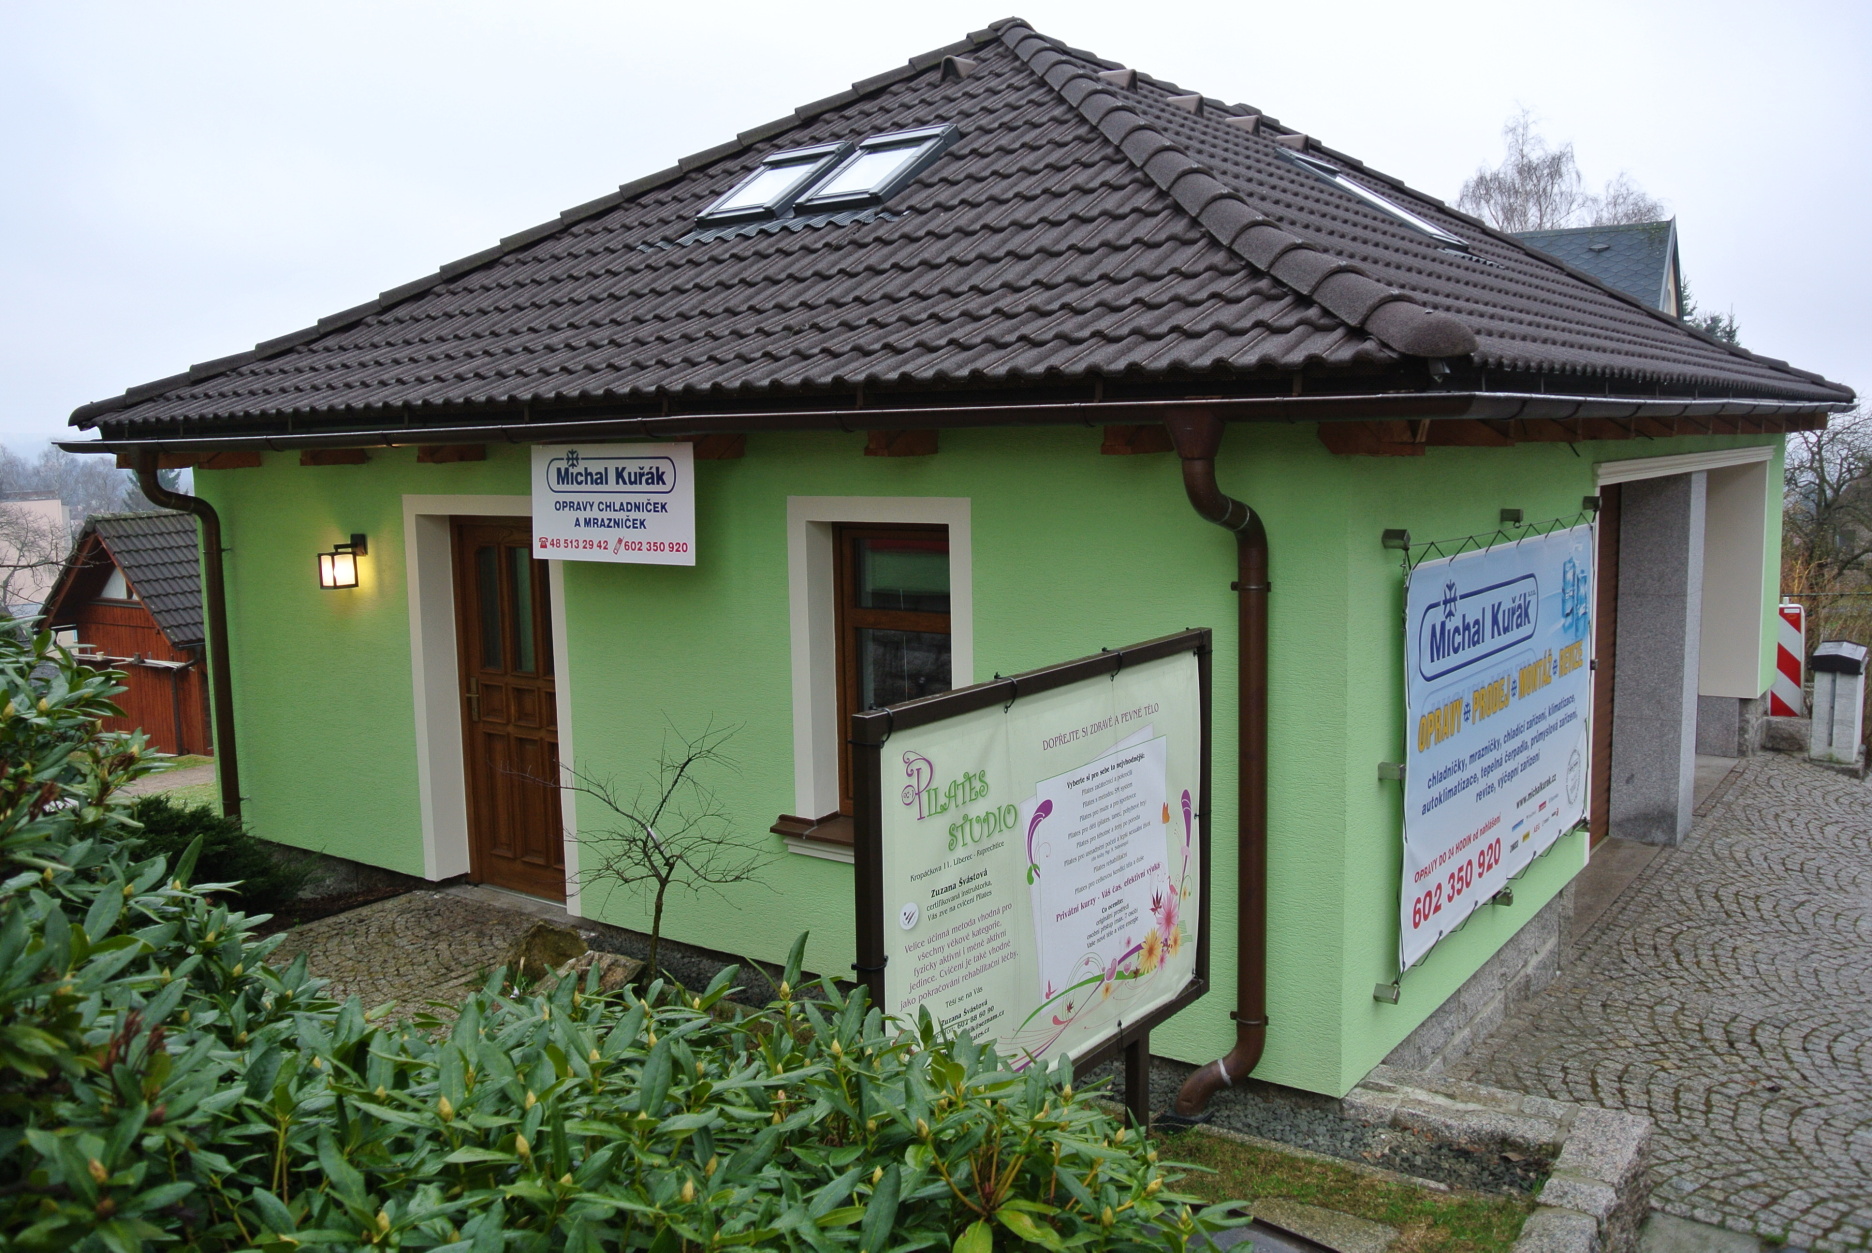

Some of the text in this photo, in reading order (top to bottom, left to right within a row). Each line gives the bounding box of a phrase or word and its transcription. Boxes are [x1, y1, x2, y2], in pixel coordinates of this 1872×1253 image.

[556, 466, 667, 486] Michal Kuřák
[554, 499, 668, 513] OPRAVY CHLADNIČEK
[574, 515, 647, 529] A MRAZNIČEK
[549, 539, 688, 553] 48 513 29 42 602 350 920
[1430, 607, 1485, 663] Michal
[1491, 592, 1531, 640] Kuřák
[1417, 698, 1463, 753] OPRAVY
[1472, 674, 1511, 725] PRODEJ
[1518, 648, 1553, 700] MONTÁŽ
[1042, 702, 1160, 751] DOPŘEJTE SI ZDRAVÉ A PEVNÉ TĚLO
[1421, 771, 1480, 815] autoklimatizace,
[1481, 753, 1503, 779] tepelná
[1504, 740, 1529, 764] čerpadla,
[1427, 757, 1468, 789] chladničky,
[1469, 738, 1502, 766] mrazničky,
[1475, 782, 1497, 803] revize,
[1498, 763, 1519, 789] výčepní
[948, 804, 1017, 851] STUDIO
[953, 853, 973, 866] Liberec
[1414, 858, 1438, 883] OPRAVY
[1439, 852, 1446, 867] DO
[1448, 849, 1455, 859] 24
[1456, 833, 1472, 855] HODIN
[1473, 828, 1479, 842] od
[927, 912, 938, 922] Vás
[938, 908, 948, 917] zve
[975, 890, 992, 902] Pilates
[930, 883, 957, 898] Zuzana
[1413, 837, 1501, 929] 602 350 920
[904, 903, 1013, 954] Velice účinná metoda vhodná pro
[917, 945, 946, 962] všechny
[946, 933, 970, 949] věkové
[908, 940, 1011, 994] jedince. Cvičení je také vhodné
[913, 961, 938, 978] fyzicky
[939, 949, 961, 966] aktivní
[966, 939, 985, 954] méně
[986, 929, 1007, 945] aktivní
[899, 949, 1019, 1013] jako pokračování rehabilitační léčby.
[945, 1000, 957, 1008] Těší
[965, 991, 973, 999] na
[973, 986, 983, 995] Vás
